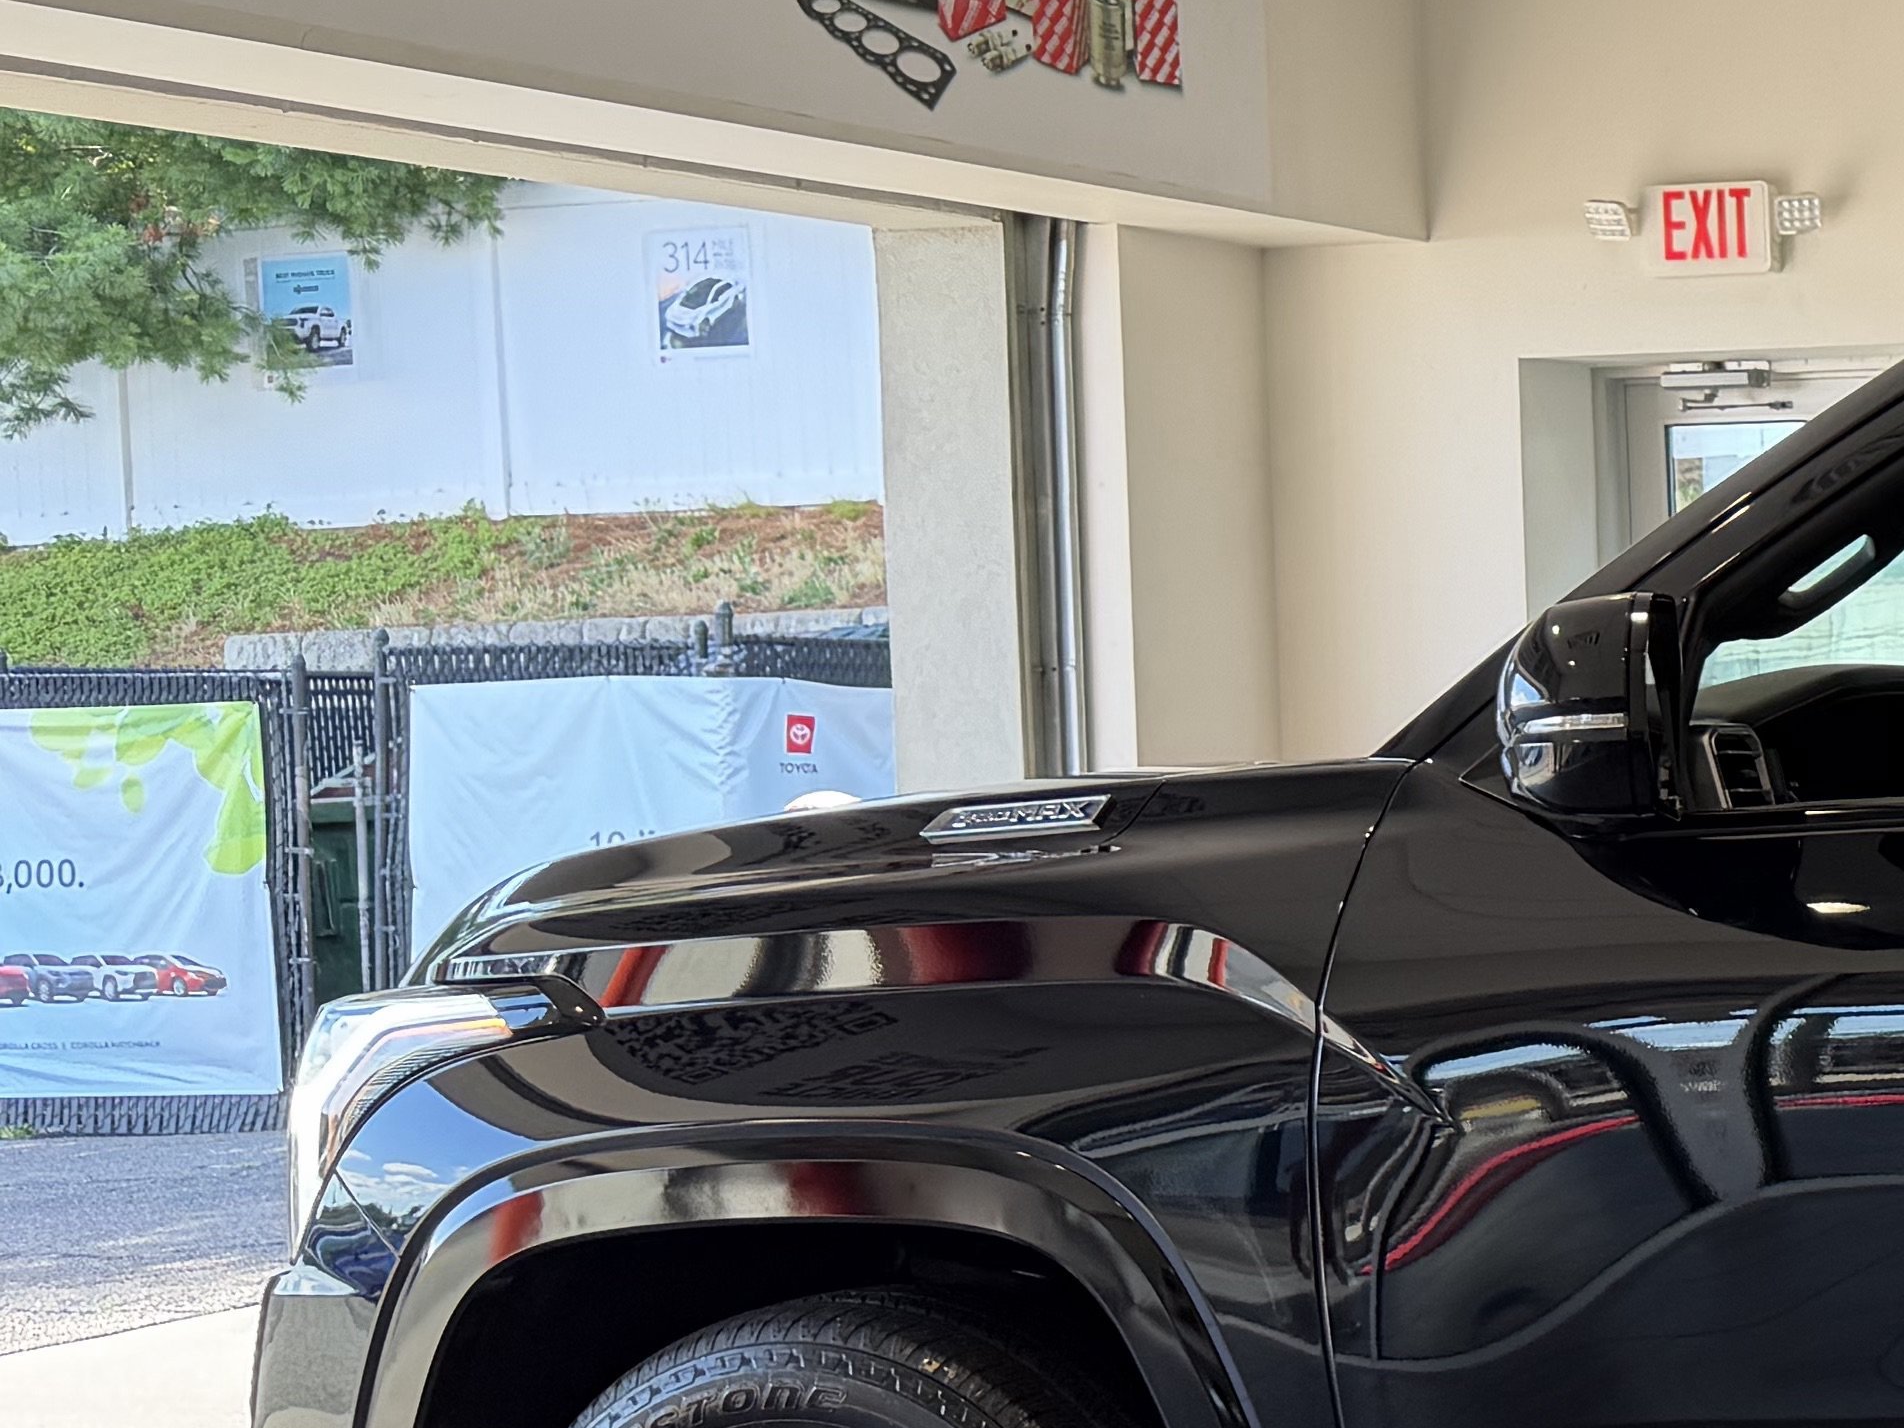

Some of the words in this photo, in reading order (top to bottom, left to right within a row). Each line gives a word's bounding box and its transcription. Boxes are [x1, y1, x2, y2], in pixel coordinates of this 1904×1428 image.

[1663, 188, 1751, 260] EXIT
[662, 241, 709, 273] 314
[0, 859, 84, 894] ,000.
